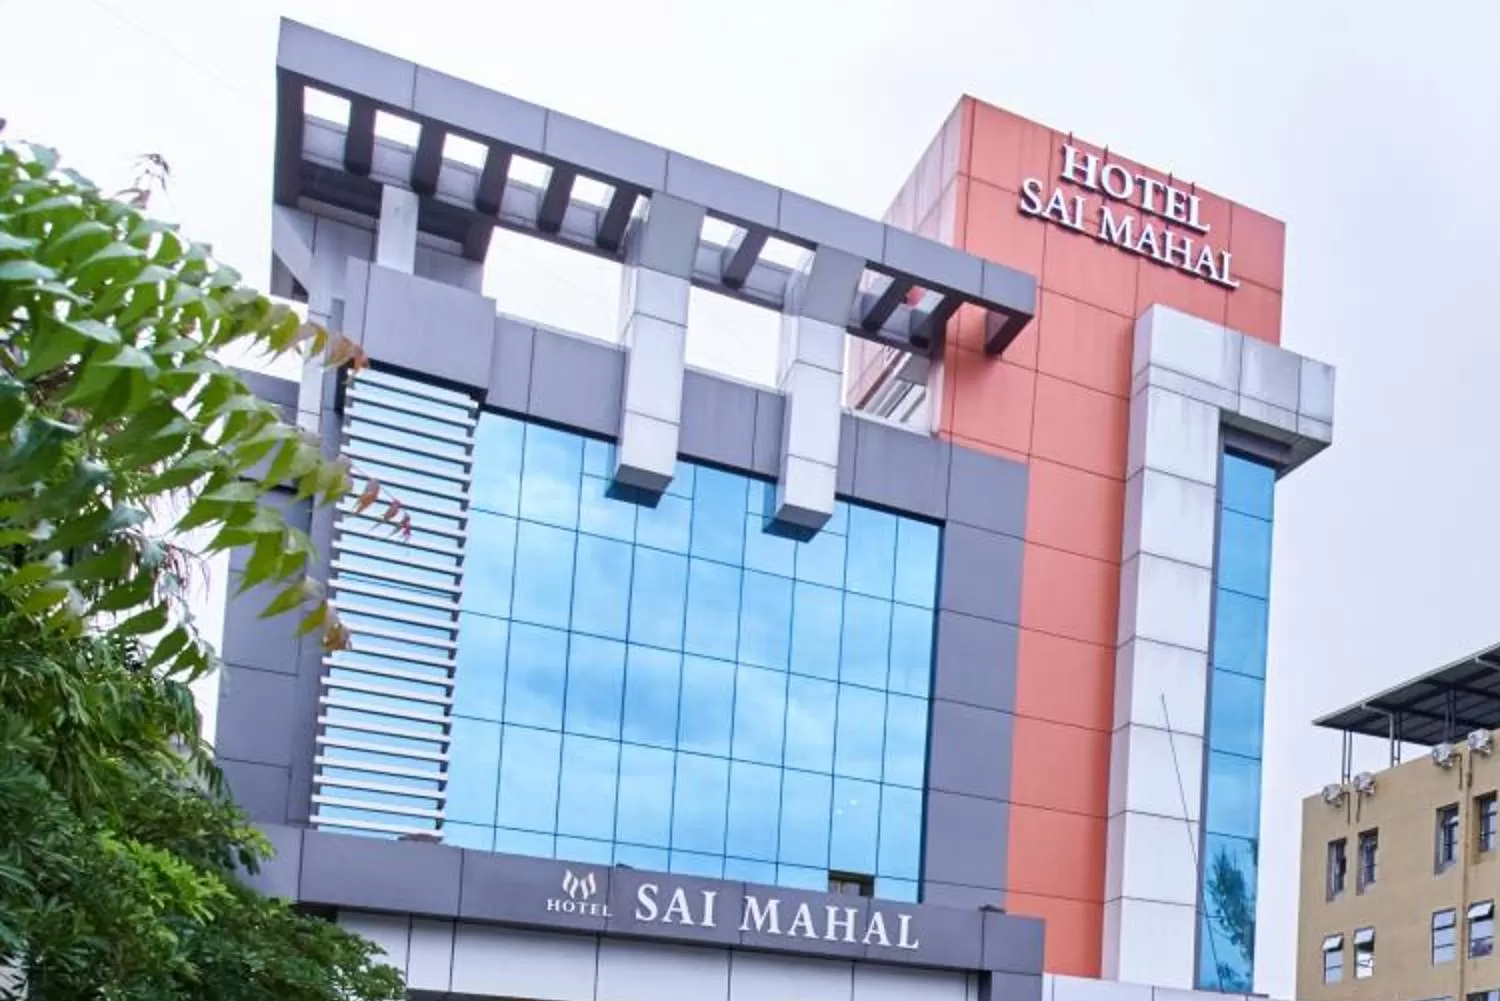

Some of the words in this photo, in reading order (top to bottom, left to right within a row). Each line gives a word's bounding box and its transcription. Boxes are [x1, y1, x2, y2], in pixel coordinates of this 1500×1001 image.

[1060, 143, 1211, 234] HOTEL
[1019, 177, 1087, 230] SAI
[1099, 205, 1241, 288] MAHAL
[547, 898, 614, 918] HOTEL
[635, 883, 719, 928] SAI
[739, 895, 921, 950] MAHAL
